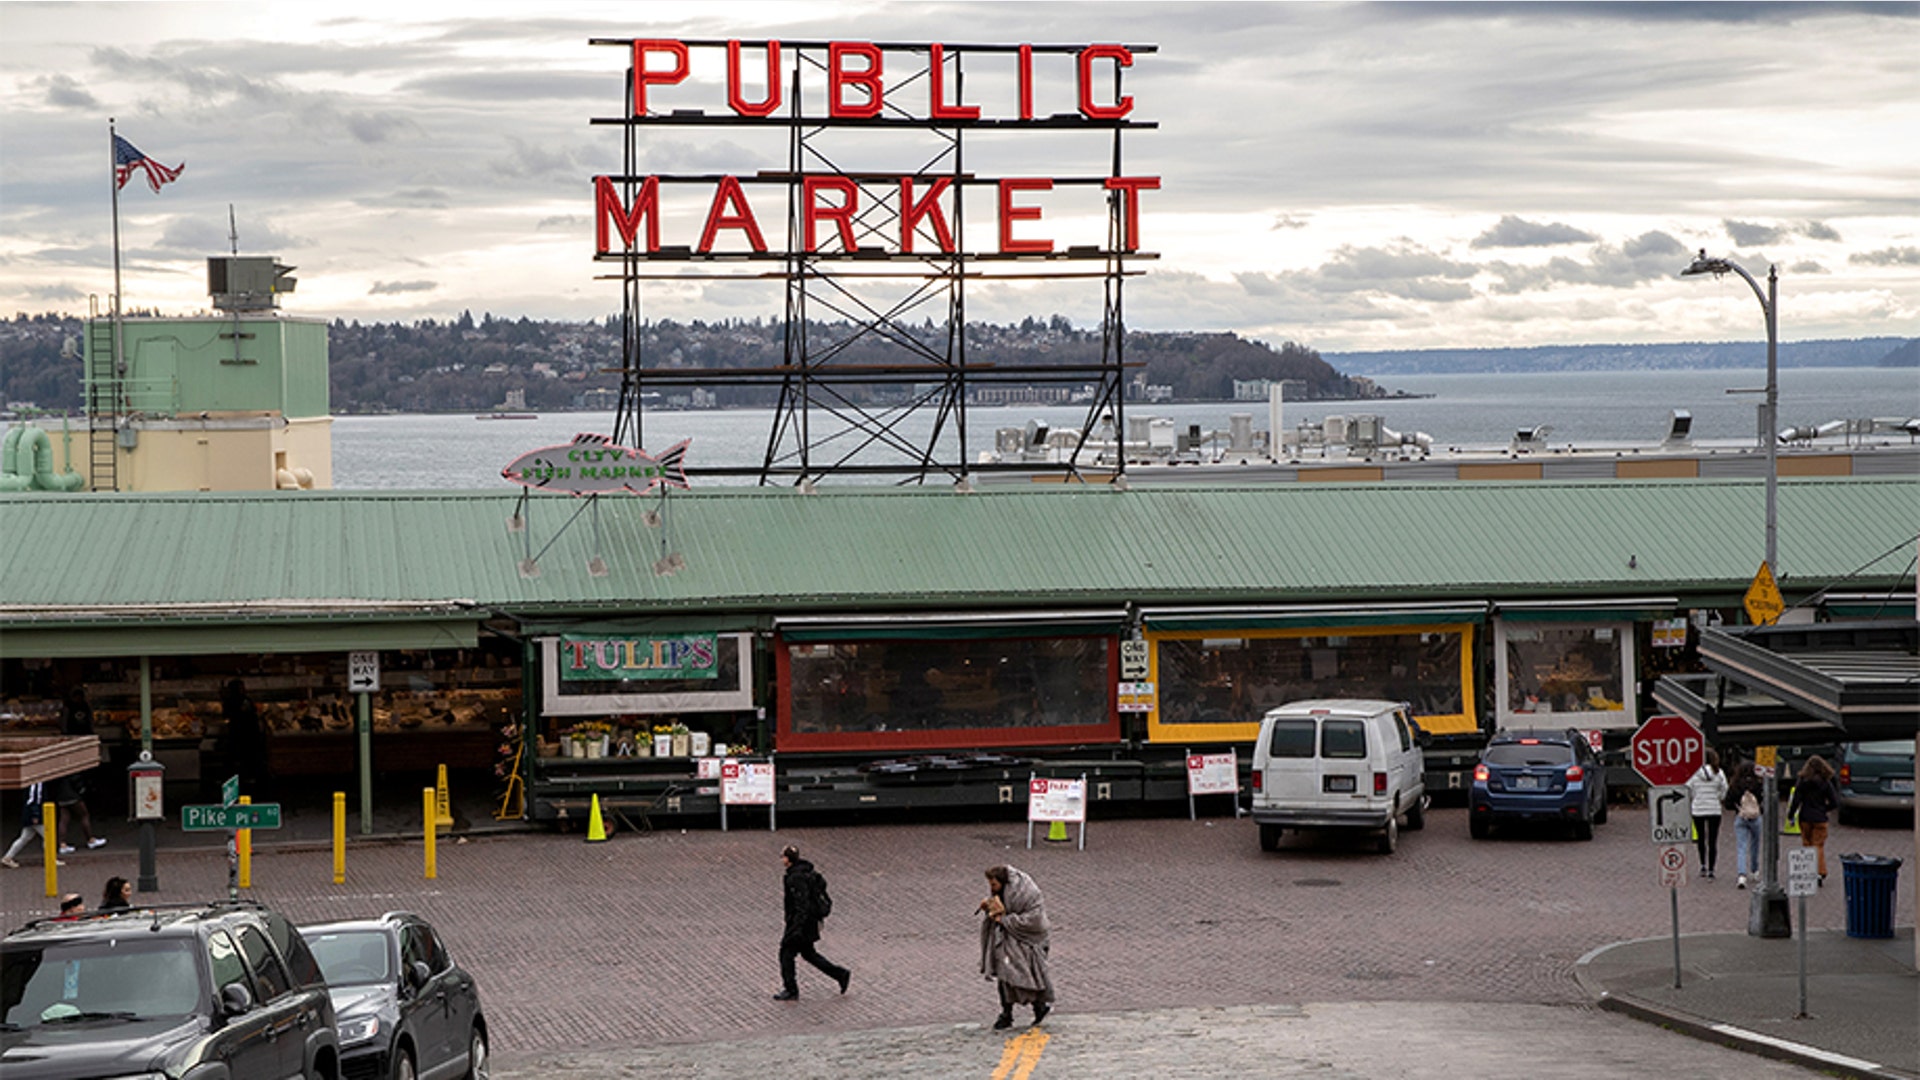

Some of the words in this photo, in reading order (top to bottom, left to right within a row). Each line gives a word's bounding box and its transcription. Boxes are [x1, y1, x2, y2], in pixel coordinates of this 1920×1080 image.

[633, 39, 1134, 119] PUBLIC
[595, 175, 1161, 253] MARKET
[565, 640, 714, 670] TULIPS
[1123, 642, 1144, 653] ONE
[353, 654, 375, 665] ONE
[1125, 654, 1146, 663] WAY
[353, 665, 375, 675] WAY
[1637, 738, 1700, 766] STOP
[189, 808, 226, 826] Pike
[235, 812, 249, 825] Pl
[1653, 827, 1689, 841] ONLY
